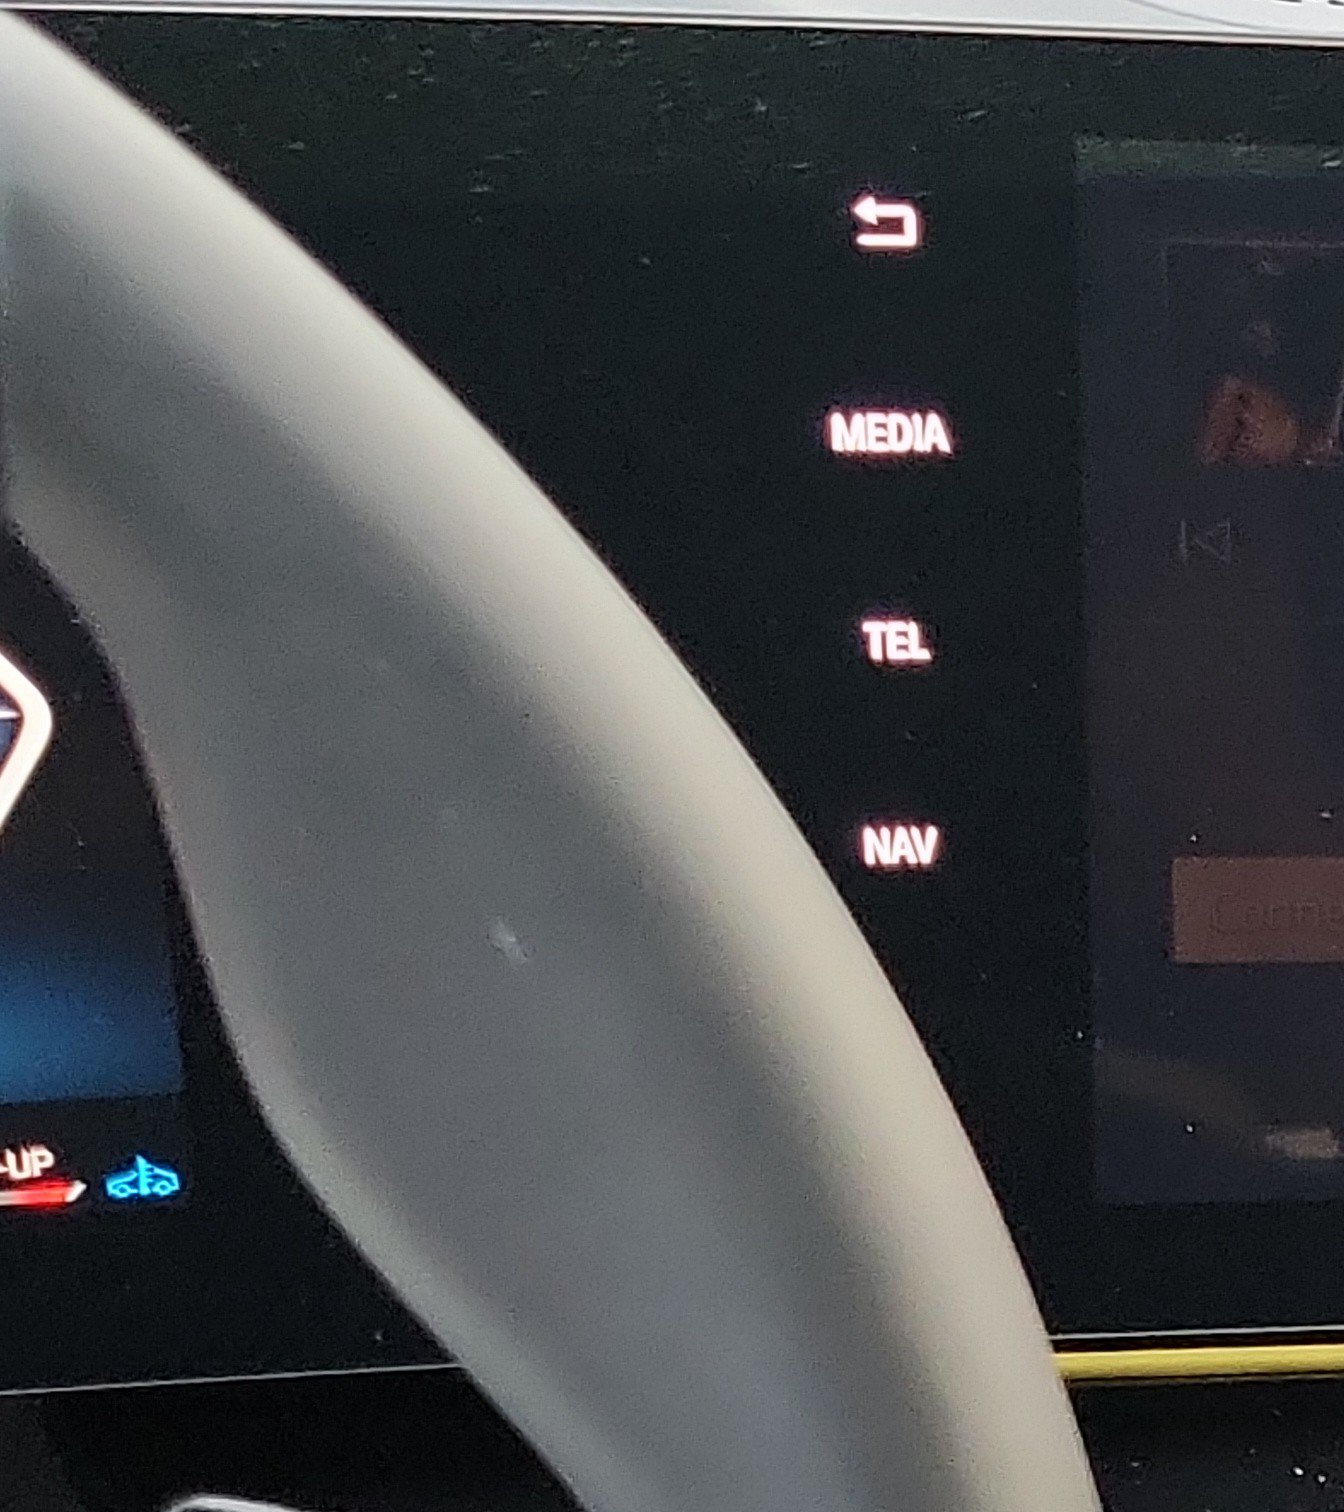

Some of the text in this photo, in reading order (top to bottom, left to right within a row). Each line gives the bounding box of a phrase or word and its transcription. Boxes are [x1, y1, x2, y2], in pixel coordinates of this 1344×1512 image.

[830, 411, 951, 454] MEDIA
[861, 620, 933, 661] TEL
[862, 824, 939, 866] NAV
